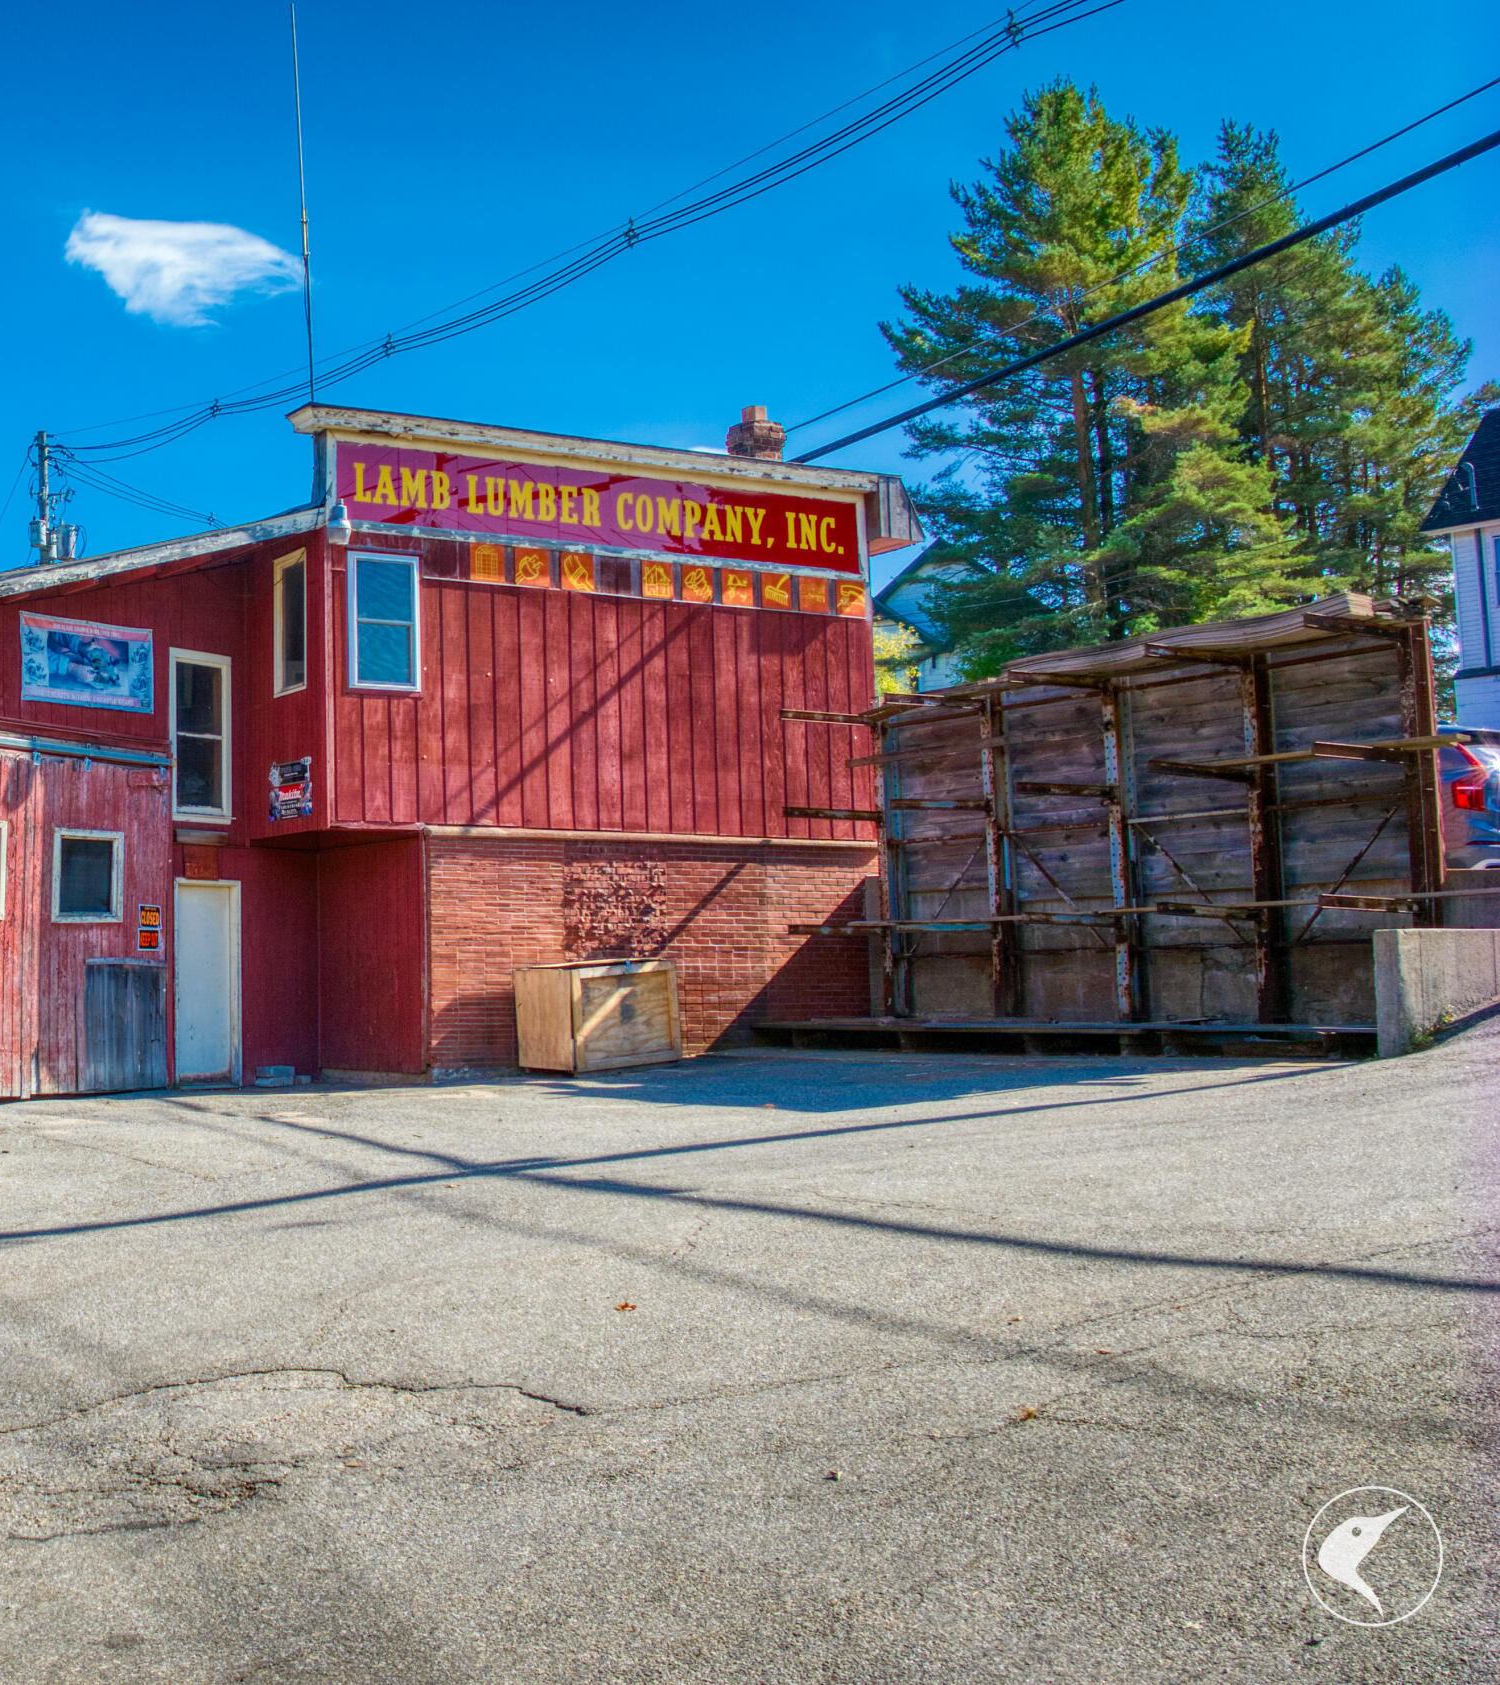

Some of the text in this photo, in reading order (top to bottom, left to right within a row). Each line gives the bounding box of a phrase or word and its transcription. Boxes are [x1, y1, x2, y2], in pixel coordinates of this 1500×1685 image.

[353, 462, 844, 555] LAMB LUMBER COMPANY, INC.
[141, 911, 159, 925] CLOSED
